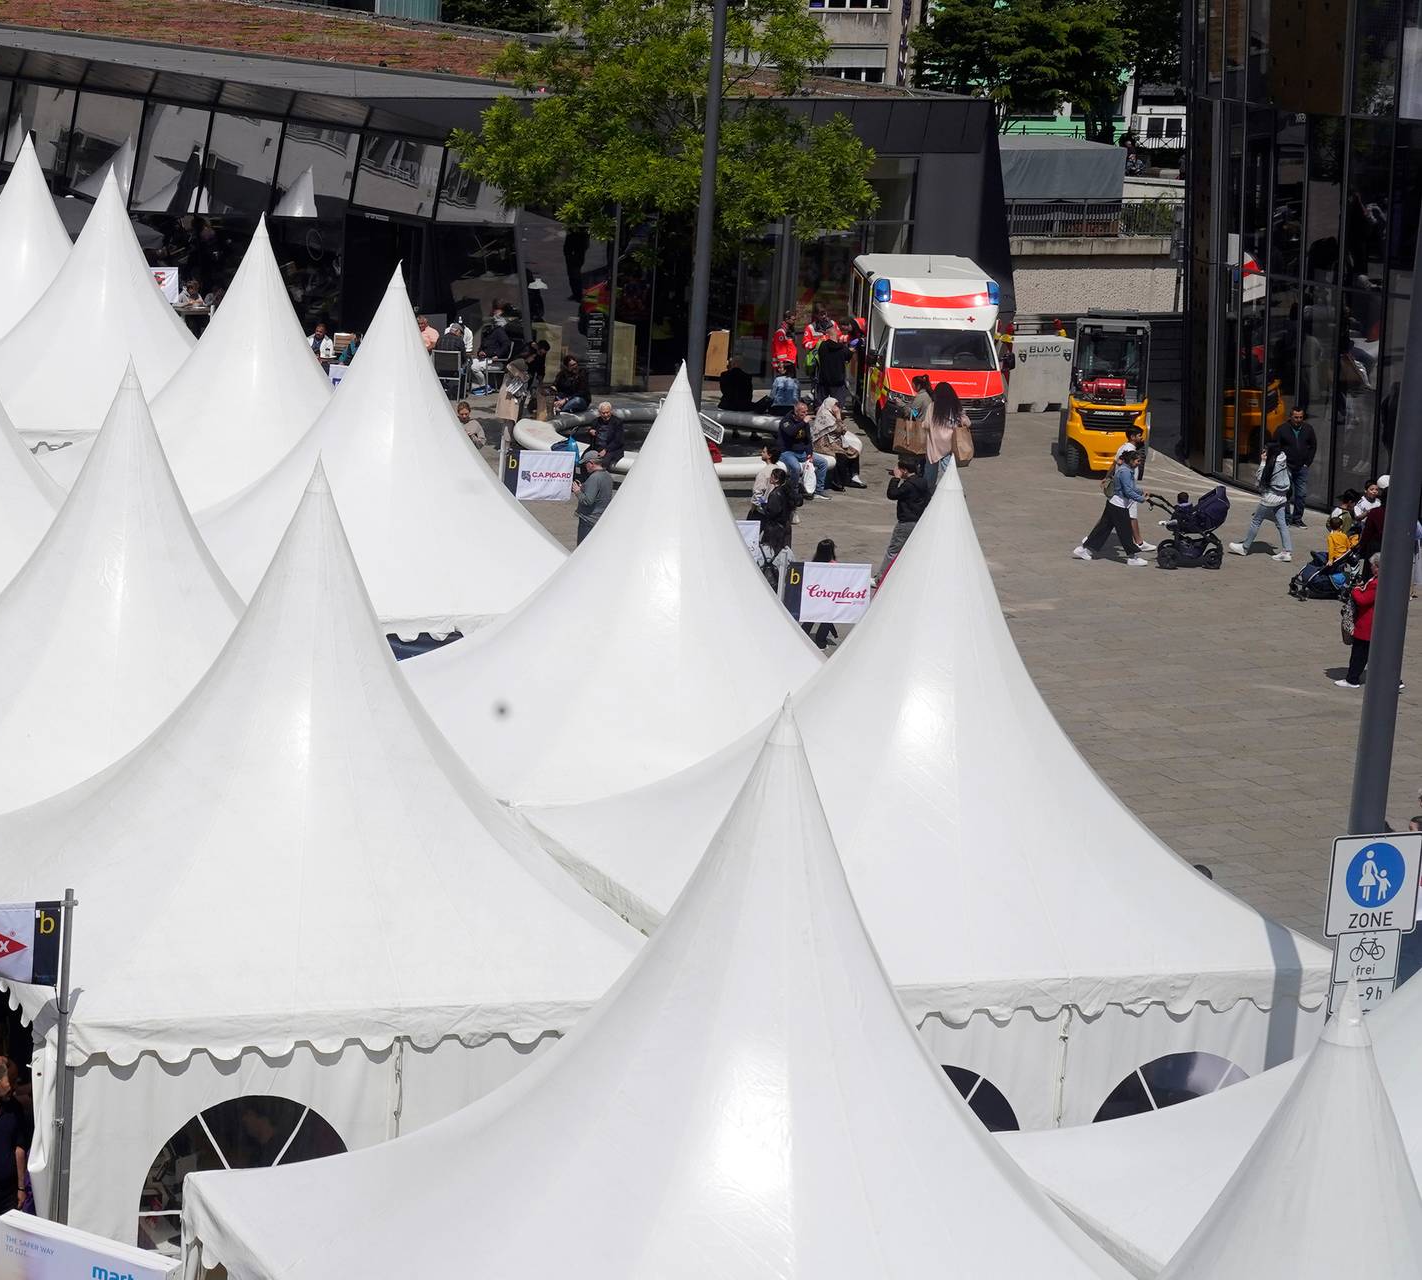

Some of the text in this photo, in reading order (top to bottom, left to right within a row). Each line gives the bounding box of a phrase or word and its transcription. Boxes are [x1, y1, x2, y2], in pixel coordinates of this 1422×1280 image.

[508, 454, 518, 469] b
[790, 568, 801, 584] b
[806, 584, 868, 602] Coroplast
[40, 911, 55, 934] b
[1348, 911, 1394, 930] ZONE
[1356, 964, 1376, 977] frei
[1375, 986, 1382, 1000] h
[6, 1235, 17, 1244] THE
[40, 1246, 55, 1256] WAY
